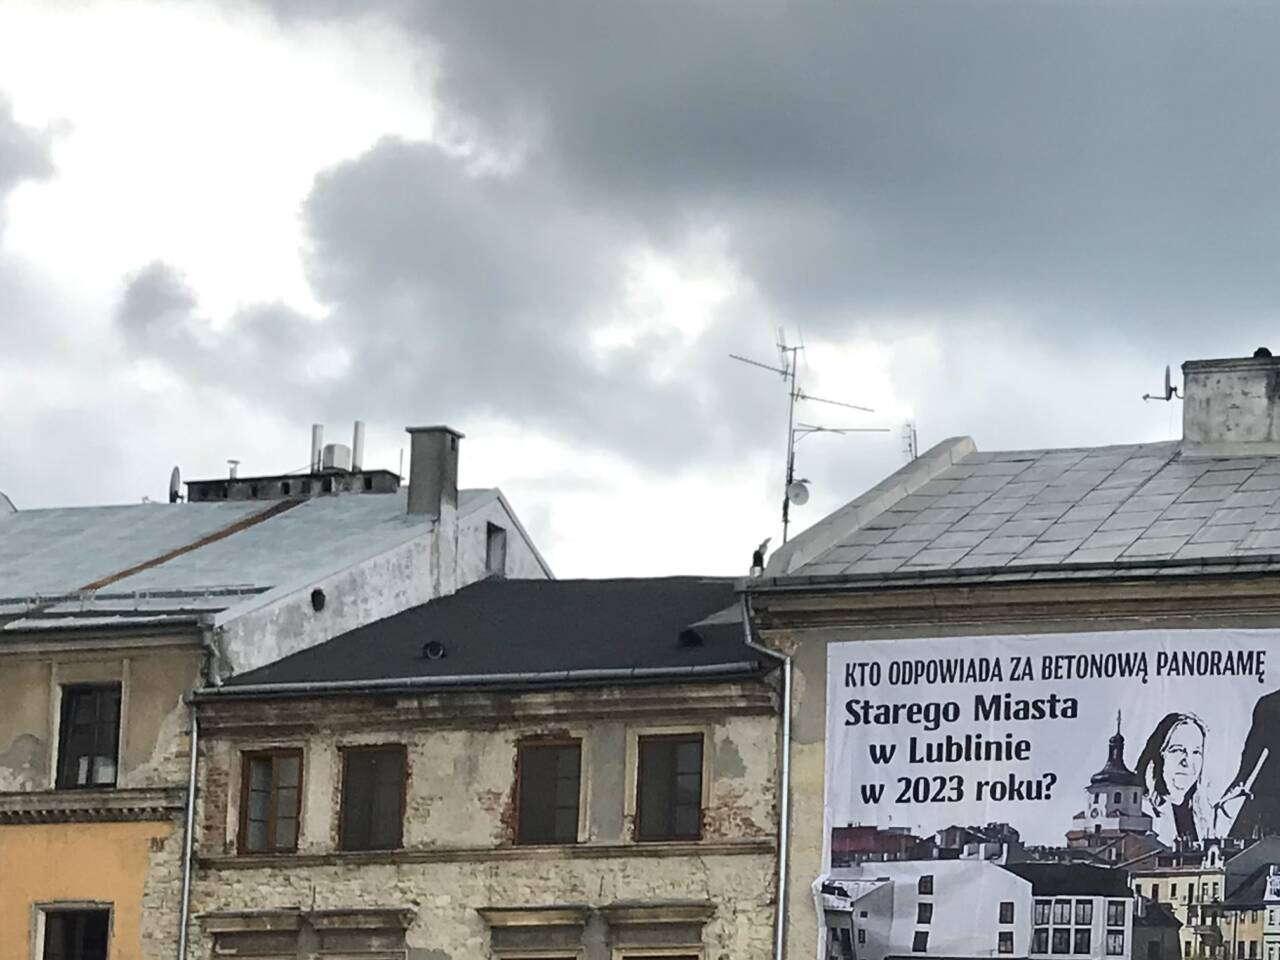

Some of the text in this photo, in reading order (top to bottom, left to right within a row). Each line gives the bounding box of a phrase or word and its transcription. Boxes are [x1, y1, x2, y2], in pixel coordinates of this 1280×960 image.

[844, 650, 1267, 688] KTO ODPOWIADA ZA BETONOWĄ PANORAMĘ
[844, 693, 1079, 731] Starego Miasta
[869, 733, 1031, 765] w Lublinie
[860, 772, 1058, 805] w 2023 roku?
